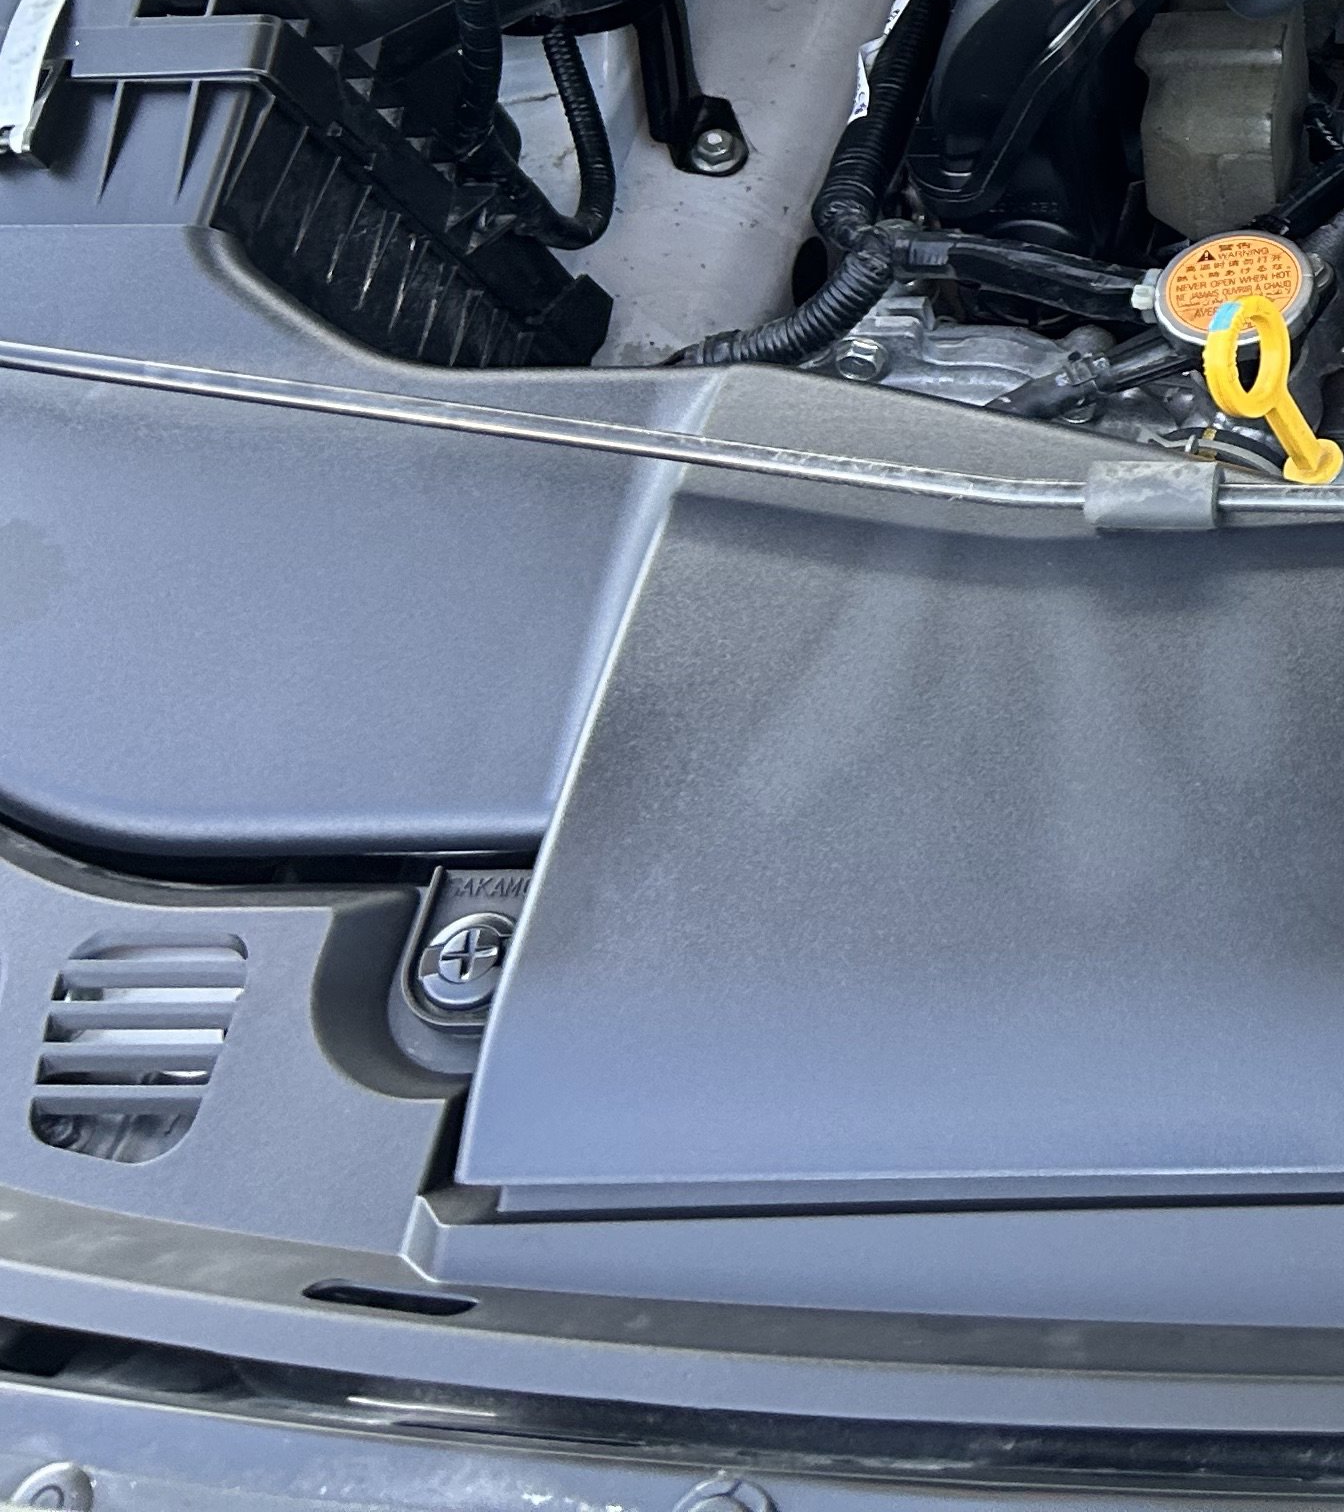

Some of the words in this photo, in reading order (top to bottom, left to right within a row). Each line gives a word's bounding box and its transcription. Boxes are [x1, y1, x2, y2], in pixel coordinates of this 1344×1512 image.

[1218, 247, 1269, 260] WARNING
[1176, 281, 1207, 292] NEVER
[1210, 277, 1236, 288] OPEN
[1239, 273, 1268, 284] WHEN
[1271, 270, 1291, 280] HOT
